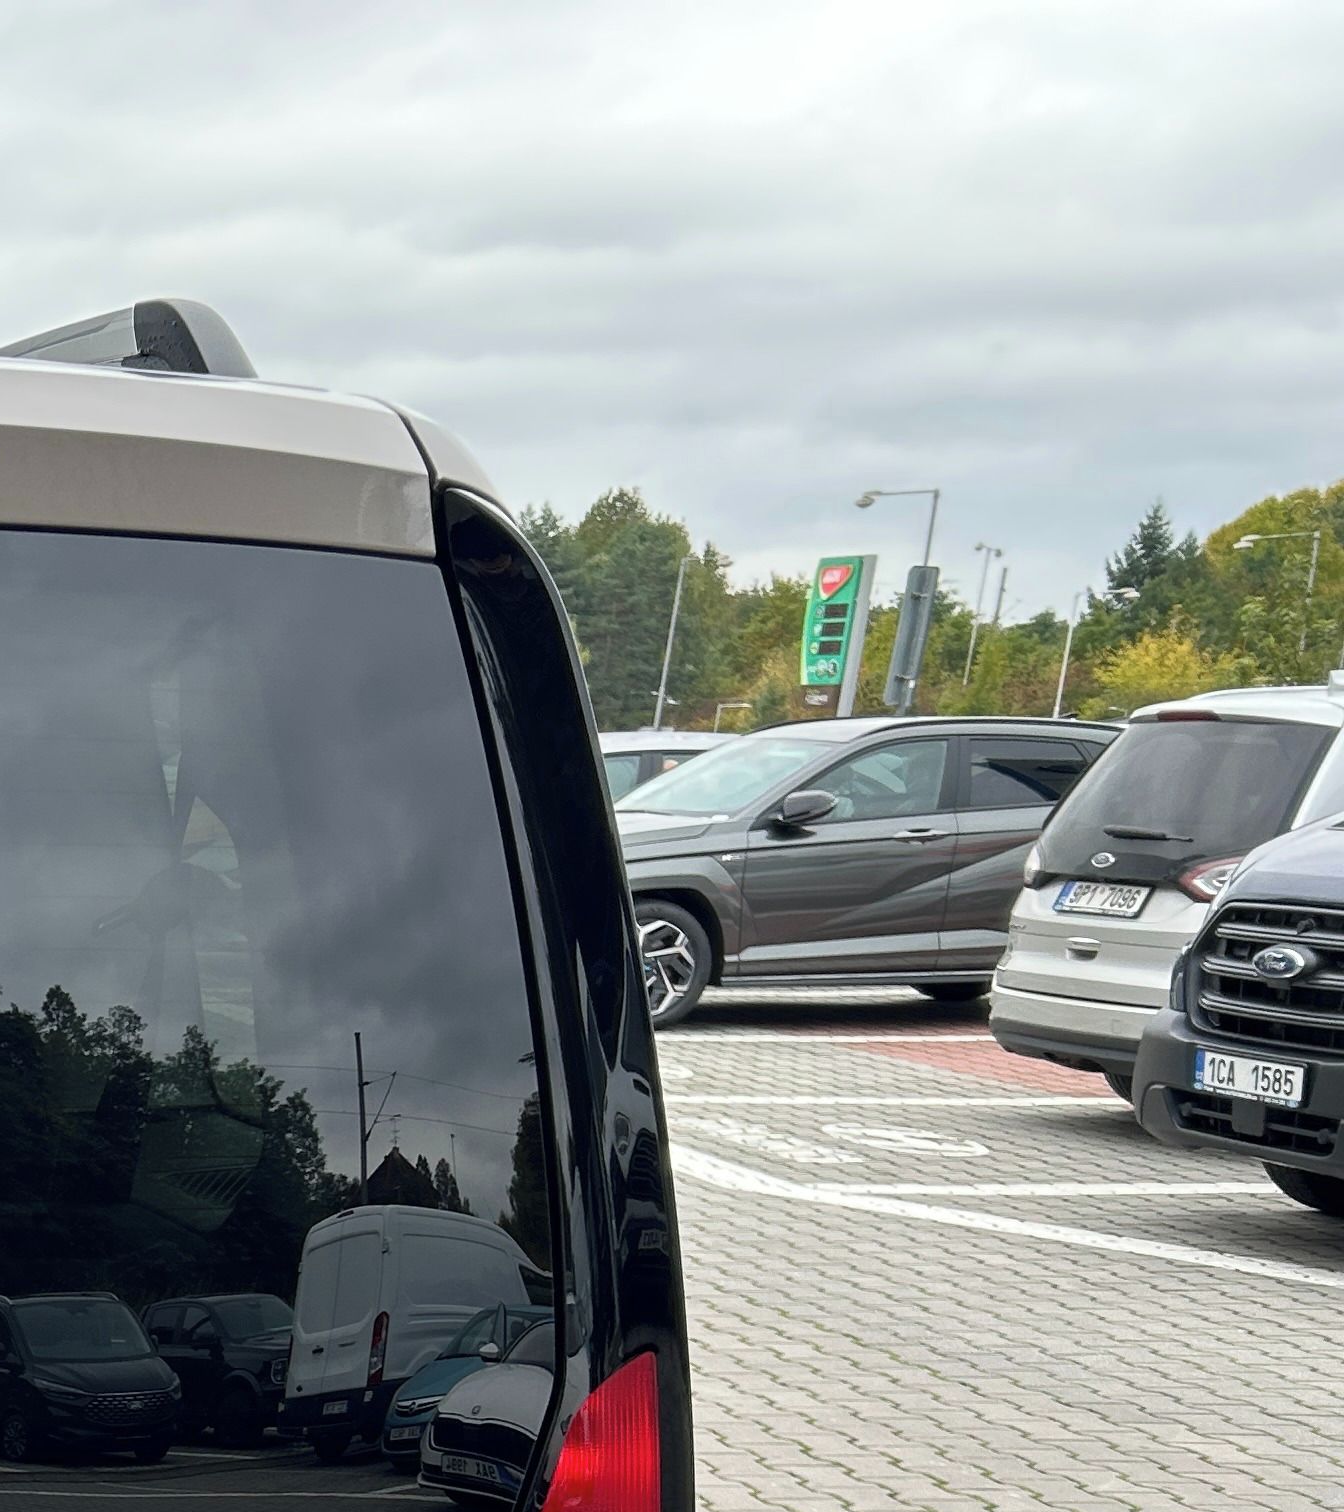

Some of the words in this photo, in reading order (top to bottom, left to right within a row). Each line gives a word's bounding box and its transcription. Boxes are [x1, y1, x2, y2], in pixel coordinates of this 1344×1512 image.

[1100, 886, 1141, 909] 7096
[1208, 1056, 1236, 1088] 1CA
[1251, 1064, 1296, 1097] 1585
